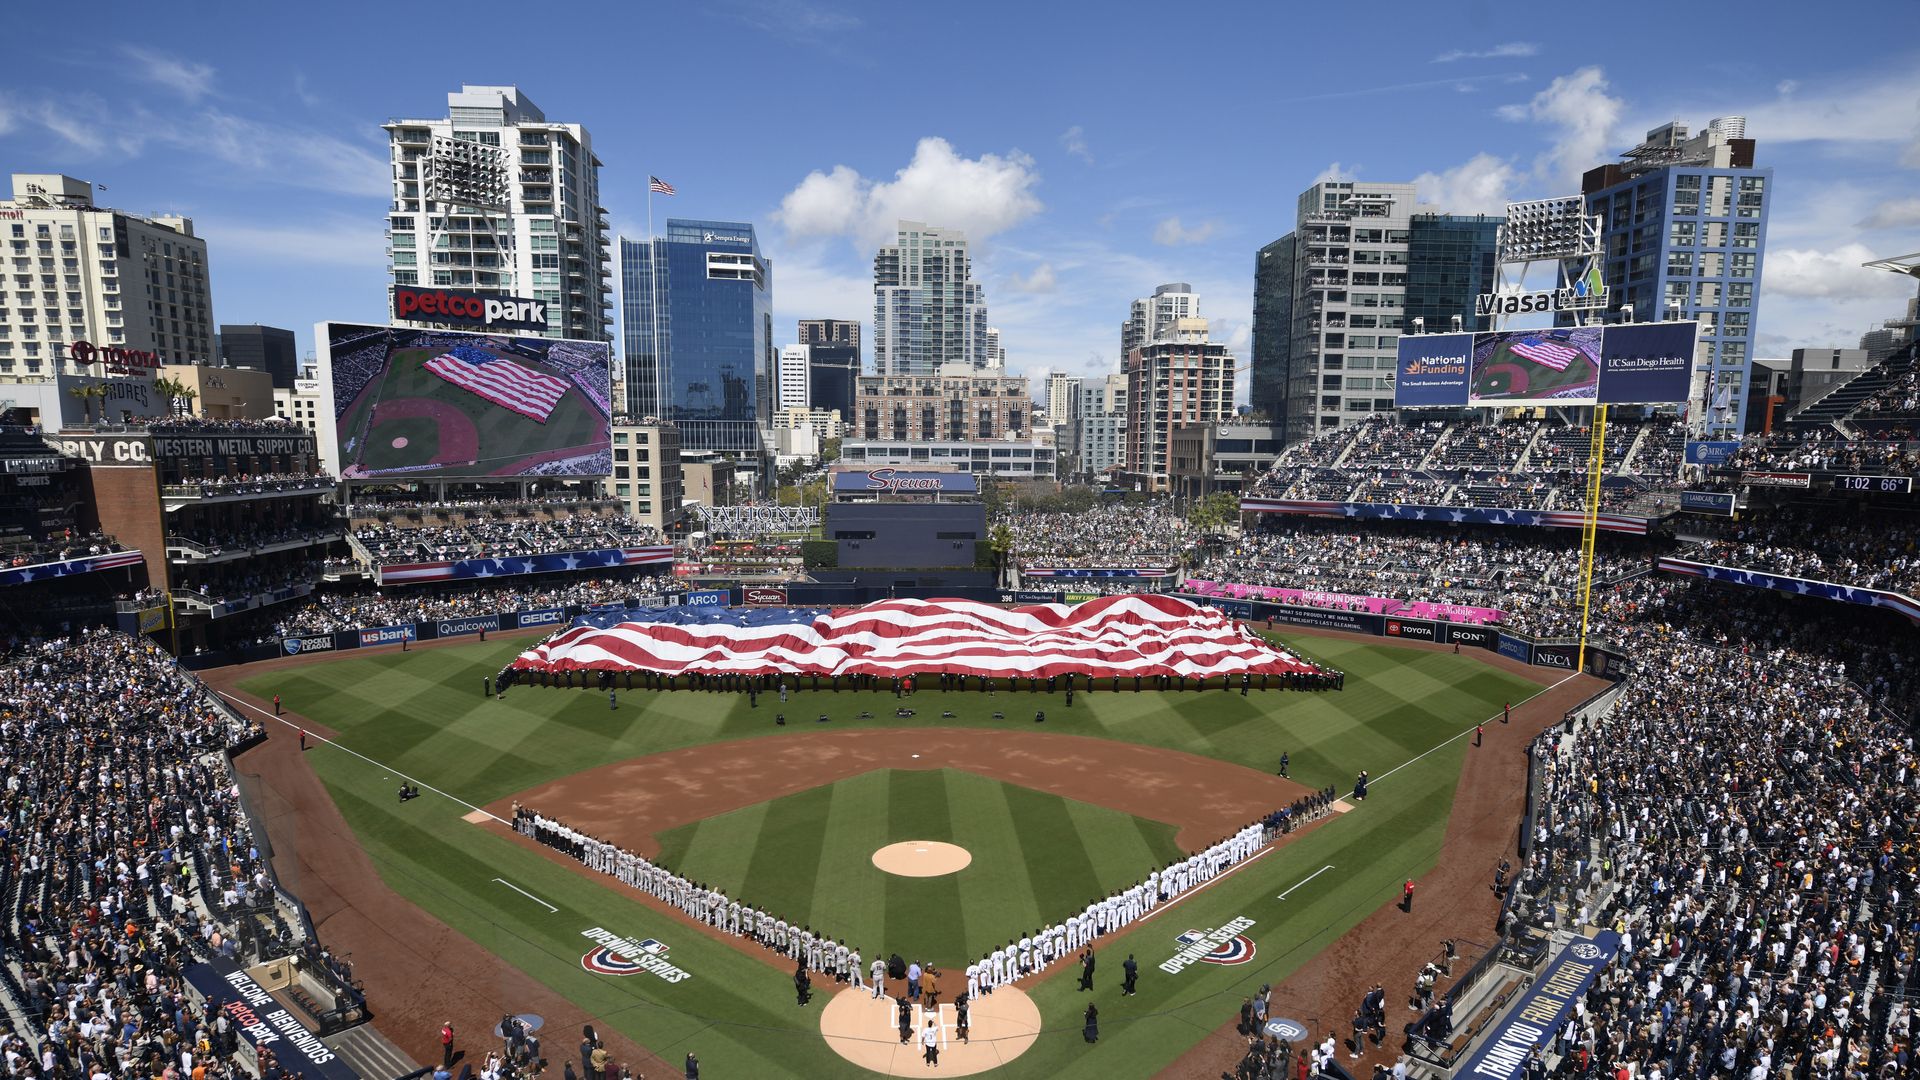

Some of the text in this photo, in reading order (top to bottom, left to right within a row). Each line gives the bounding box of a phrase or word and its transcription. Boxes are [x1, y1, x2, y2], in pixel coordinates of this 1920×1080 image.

[714, 234, 733, 242] Sempra
[399, 290, 546, 324] petco park
[1479, 288, 1565, 316] Viasat
[100, 346, 161, 368] TOYOTA
[1421, 355, 1466, 365] National
[1608, 357, 1685, 368] UC San Diego Health
[1420, 365, 1465, 375] Funding
[113, 440, 152, 462] CO.
[153, 439, 314, 457] WESTERN METAL SUPPLY CO.
[1707, 446, 1725, 456] MRC
[16, 476, 50, 487] SPIRITS
[867, 468, 943, 496] Sycuan
[1844, 477, 1870, 491] 1:02
[697, 506, 821, 522] NATIONAL
[707, 521, 811, 534] UNIVERSITY
[689, 595, 717, 605] ARCO
[748, 590, 782, 602] Sycuan
[1302, 592, 1366, 605] HOME RUN DECK
[142, 612, 163, 630] Snapple
[1290, 617, 1318, 625] TWILIGHT'S
[1303, 611, 1327, 619] PROUDLY
[440, 618, 497, 635] Qualcomm
[1402, 626, 1432, 636] TOYOTA
[302, 637, 331, 646] ROCKET
[1452, 630, 1488, 641] SONY
[302, 643, 332, 651] LEAGUE
[1499, 639, 1518, 654] petco
[1537, 653, 1571, 666] NECA
[1158, 915, 1256, 975] OPENING SERIES
[580, 927, 692, 984] OPENING SERIES
[1541, 960, 1594, 999] FAITHFUL
[224, 970, 273, 1007] WELCOME
[1519, 995, 1565, 1026] FRIAR
[225, 1000, 280, 1045] petco park
[265, 1009, 335, 1065] BIENVENIDOS
[1504, 1021, 1543, 1046] YOU
[1474, 1040, 1530, 1080] THANK
